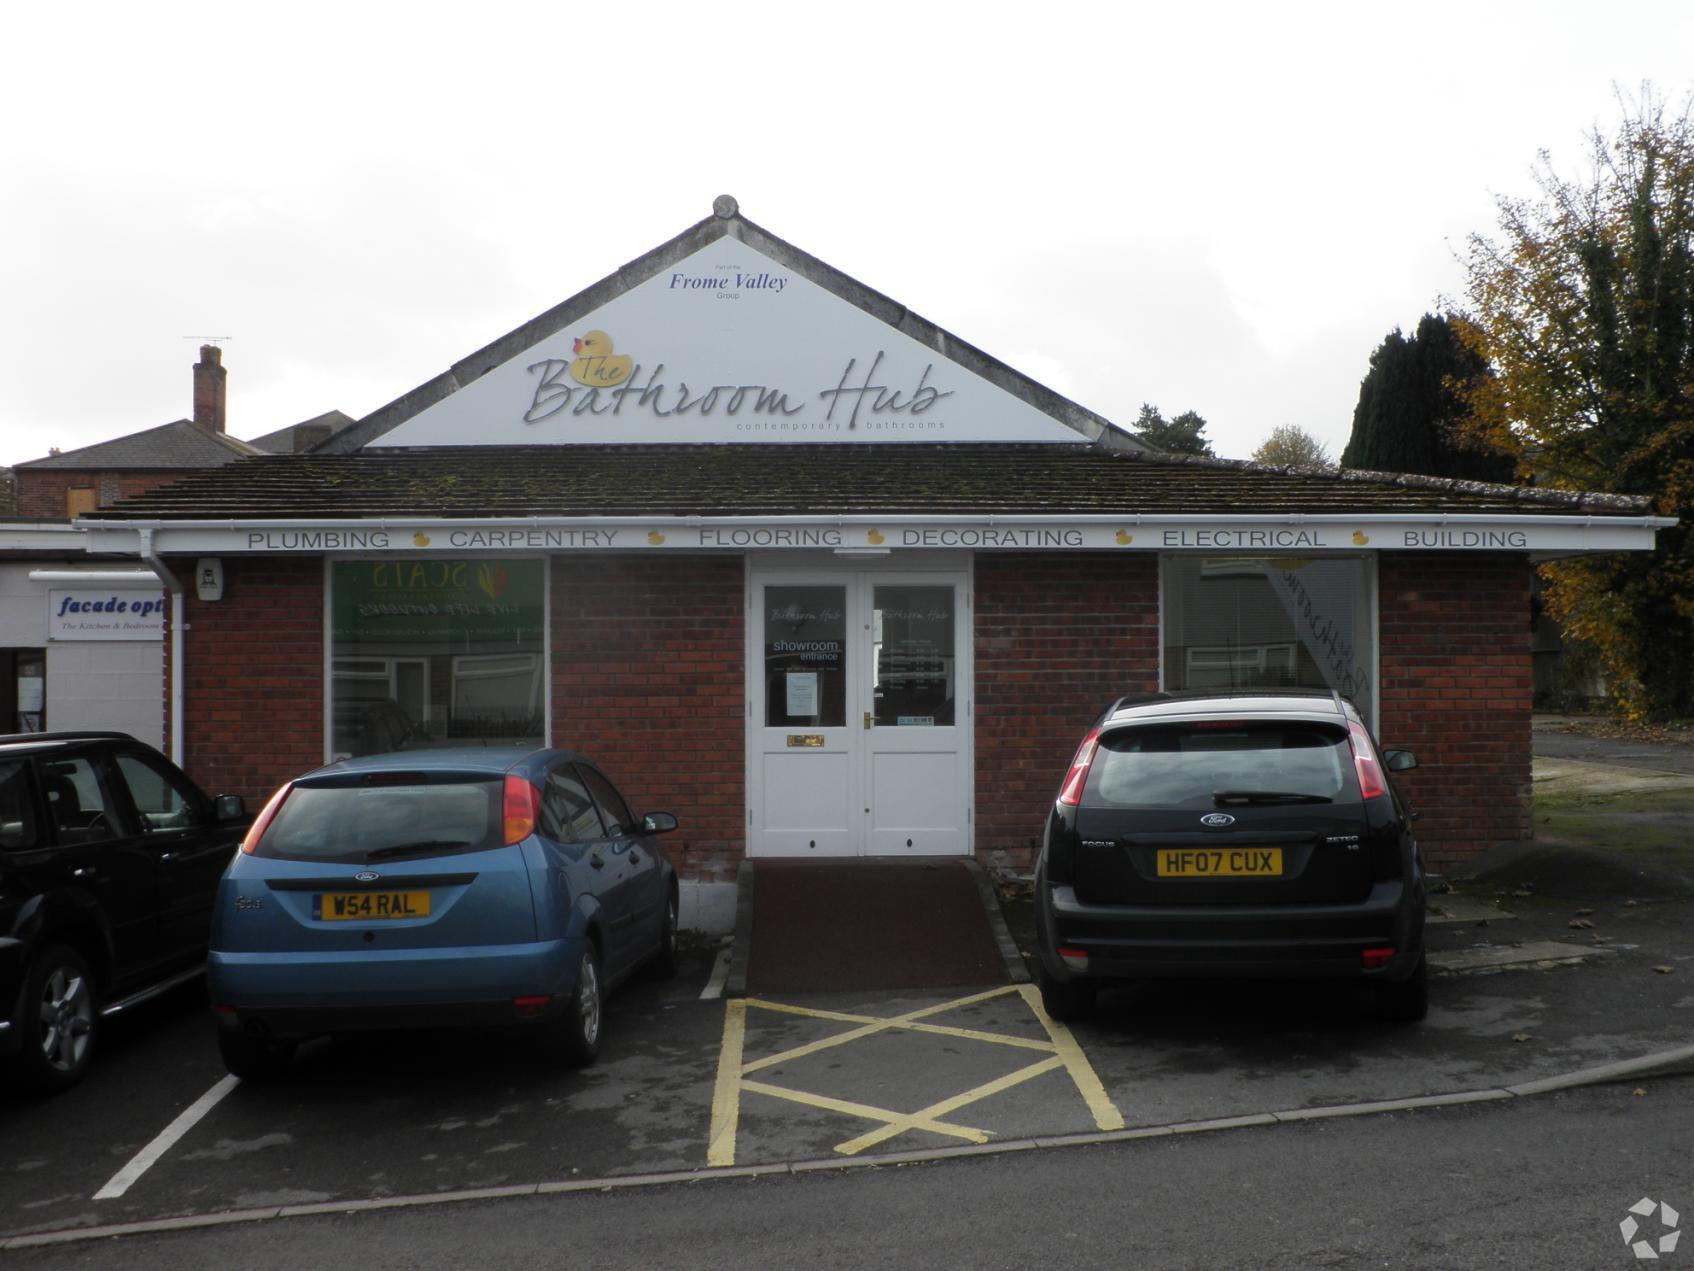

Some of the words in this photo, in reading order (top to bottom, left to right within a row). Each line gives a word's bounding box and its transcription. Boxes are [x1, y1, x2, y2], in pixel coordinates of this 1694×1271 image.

[669, 273, 729, 289] Frome
[735, 273, 788, 293] Valley
[716, 292, 740, 300] Group
[579, 355, 625, 381] The
[523, 358, 806, 424] Bathroom
[820, 350, 955, 430] Hub
[736, 421, 841, 432] contemporary
[866, 420, 945, 430] bathrooms
[248, 531, 390, 549] PLUMBING
[449, 529, 619, 547] CARPENTRY
[701, 529, 842, 546] FLOORING
[903, 529, 1083, 546] DECORATING
[1163, 530, 1328, 547] ELECTRICAL
[1404, 530, 1527, 547] BUILDING
[57, 596, 127, 617] facade
[131, 599, 163, 617] opt
[62, 622, 76, 630] The
[80, 622, 110, 630] Kitchen
[123, 622, 159, 630] Bedroom
[774, 640, 838, 651] showroom
[800, 652, 838, 660] entrance
[1082, 840, 1115, 848] FOCUS
[1166, 852, 1222, 872] HF07
[1230, 852, 1273, 871] CUX
[334, 895, 372, 915] W54
[377, 893, 416, 914] RAL
